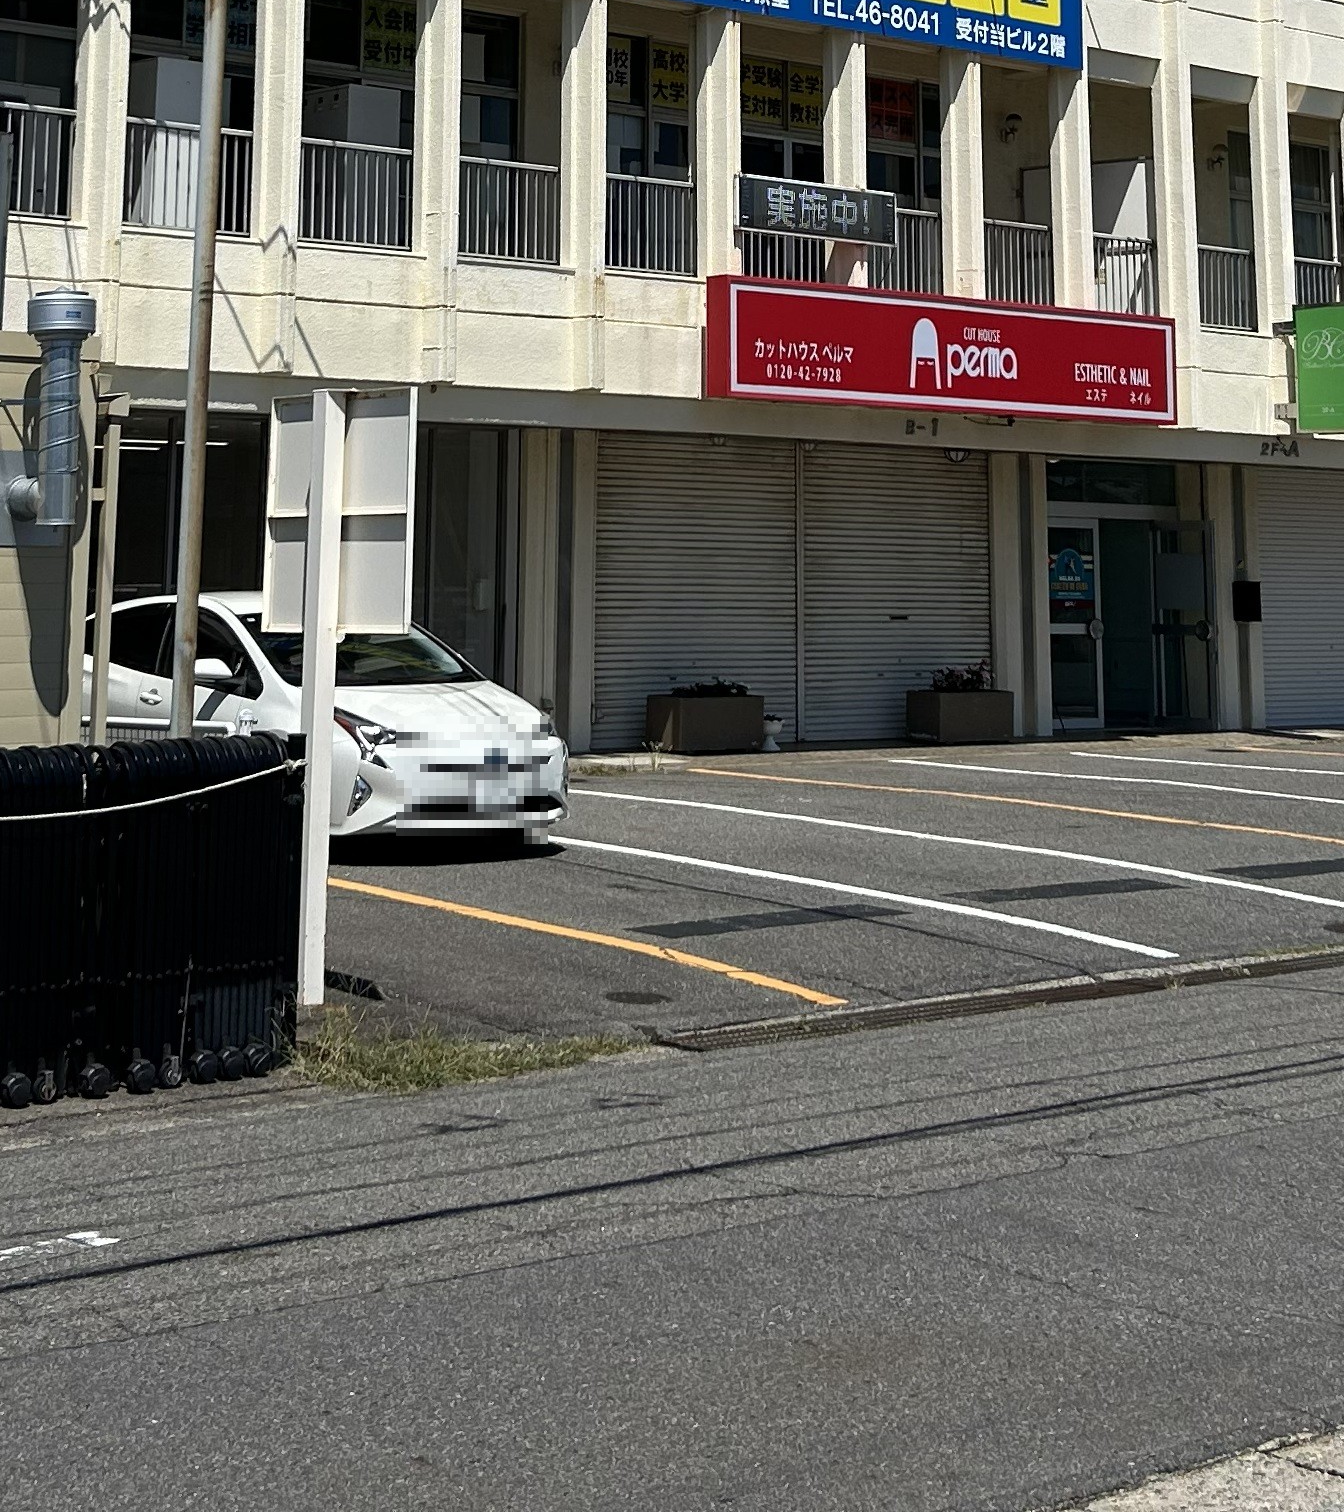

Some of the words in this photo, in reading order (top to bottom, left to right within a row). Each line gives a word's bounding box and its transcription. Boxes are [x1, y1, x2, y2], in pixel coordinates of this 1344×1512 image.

[956, 16, 1067, 60] 受付当ビル2階
[963, 326, 977, 341] CUT
[977, 327, 1001, 344] HOUSE
[754, 338, 820, 362] カットハウス
[822, 341, 854, 364] ペルマ
[766, 363, 842, 383] 0120-42-7928
[1074, 362, 1117, 385] ESTHETIC
[1119, 367, 1128, 386] &
[1129, 367, 1152, 388] NAIL
[1085, 388, 1108, 403] エステ
[1129, 391, 1152, 406] ネイル
[905, 418, 940, 437] B-1
